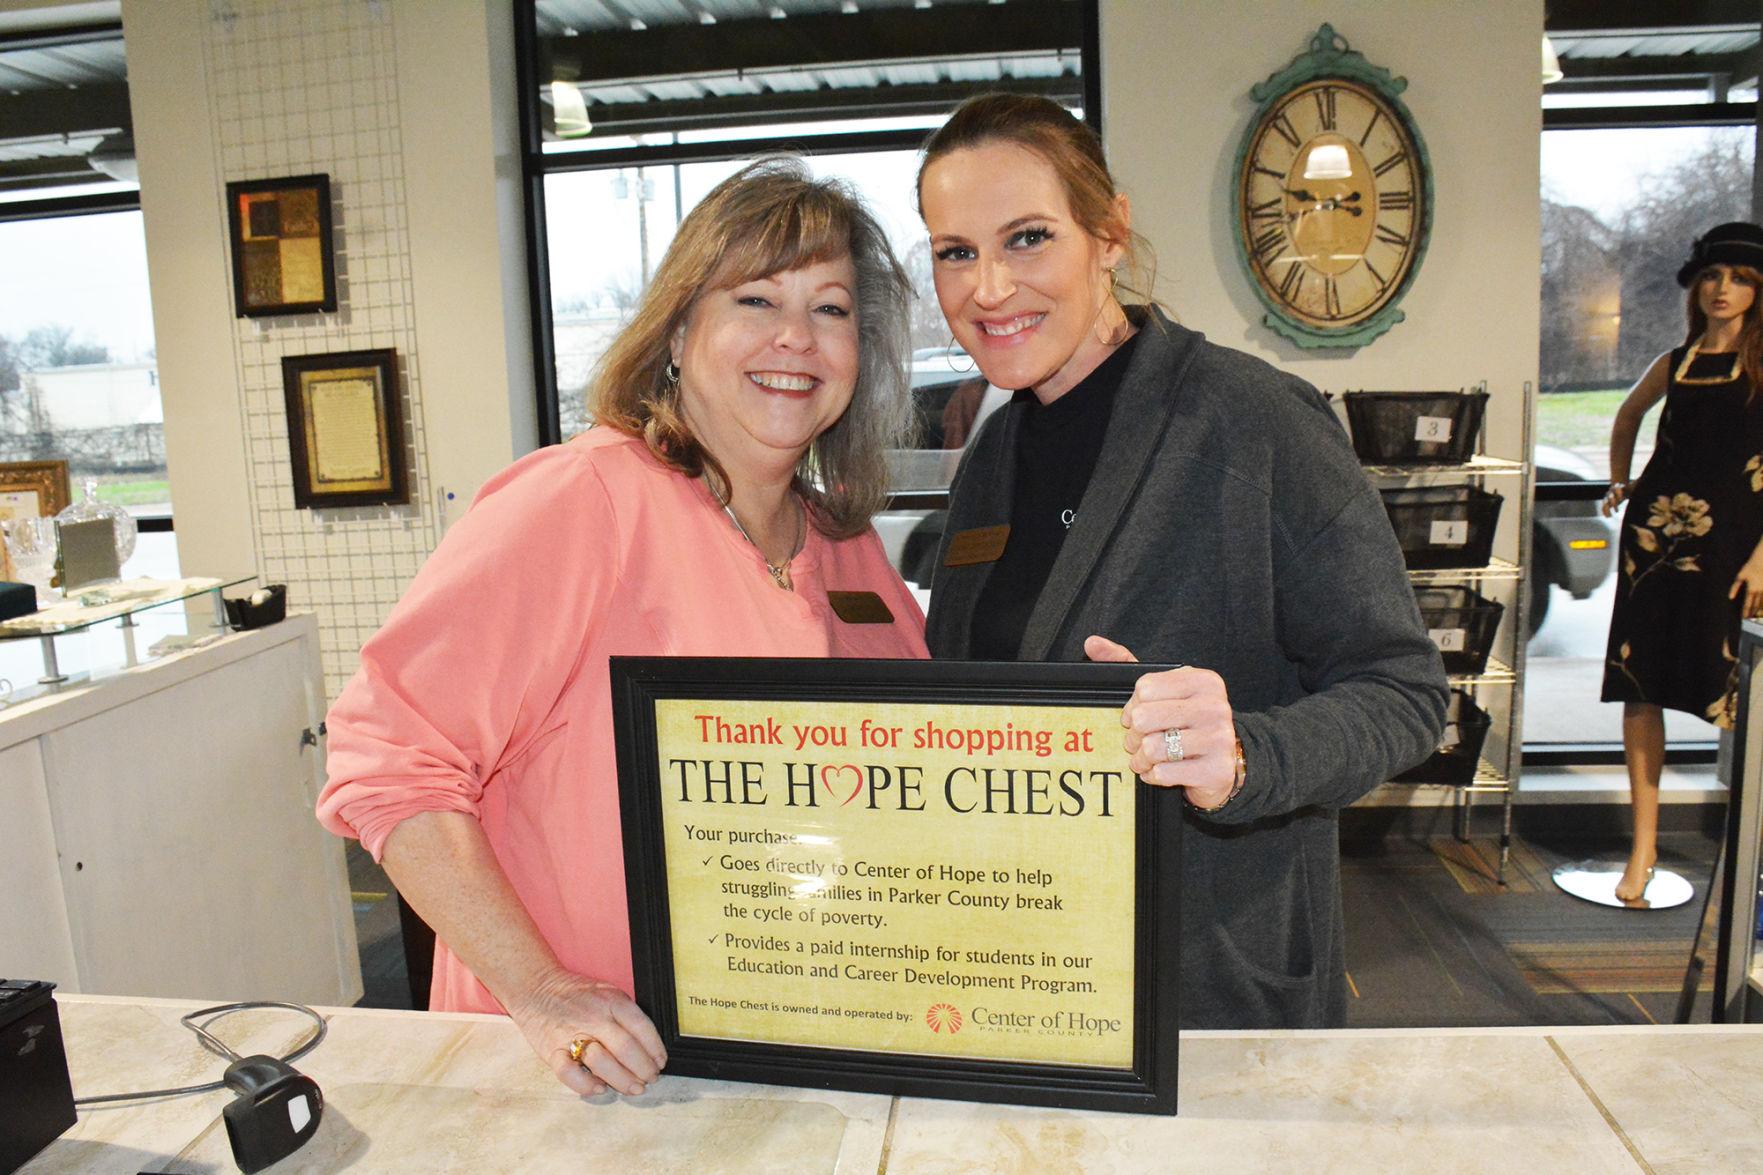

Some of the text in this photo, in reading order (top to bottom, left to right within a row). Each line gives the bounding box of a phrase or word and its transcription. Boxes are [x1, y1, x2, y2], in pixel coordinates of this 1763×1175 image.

[1427, 421, 1438, 436] 3
[1445, 526, 1453, 539] 4
[1441, 632, 1452, 647] 6
[694, 715, 1094, 757] Thank you for shopping at
[669, 759, 768, 805] THE
[944, 767, 1122, 817] CHEST
[684, 825, 722, 841] Your
[720, 854, 1053, 888] Goes directly to Center of Hope to help
[869, 885, 883, 902] in
[889, 888, 941, 905] Parker
[948, 890, 1010, 910] County
[1016, 894, 1063, 910] break
[723, 903, 888, 929] the cycle of poverty.
[725, 933, 1093, 969] Provides a paid internship for students in our
[728, 956, 1097, 994] Education and Career Development Program.
[689, 996, 913, 1022] The Hope Chest is owned and operated by:
[971, 1006, 1121, 1036] Center of Hope
[979, 1026, 1030, 1034] PARKER
